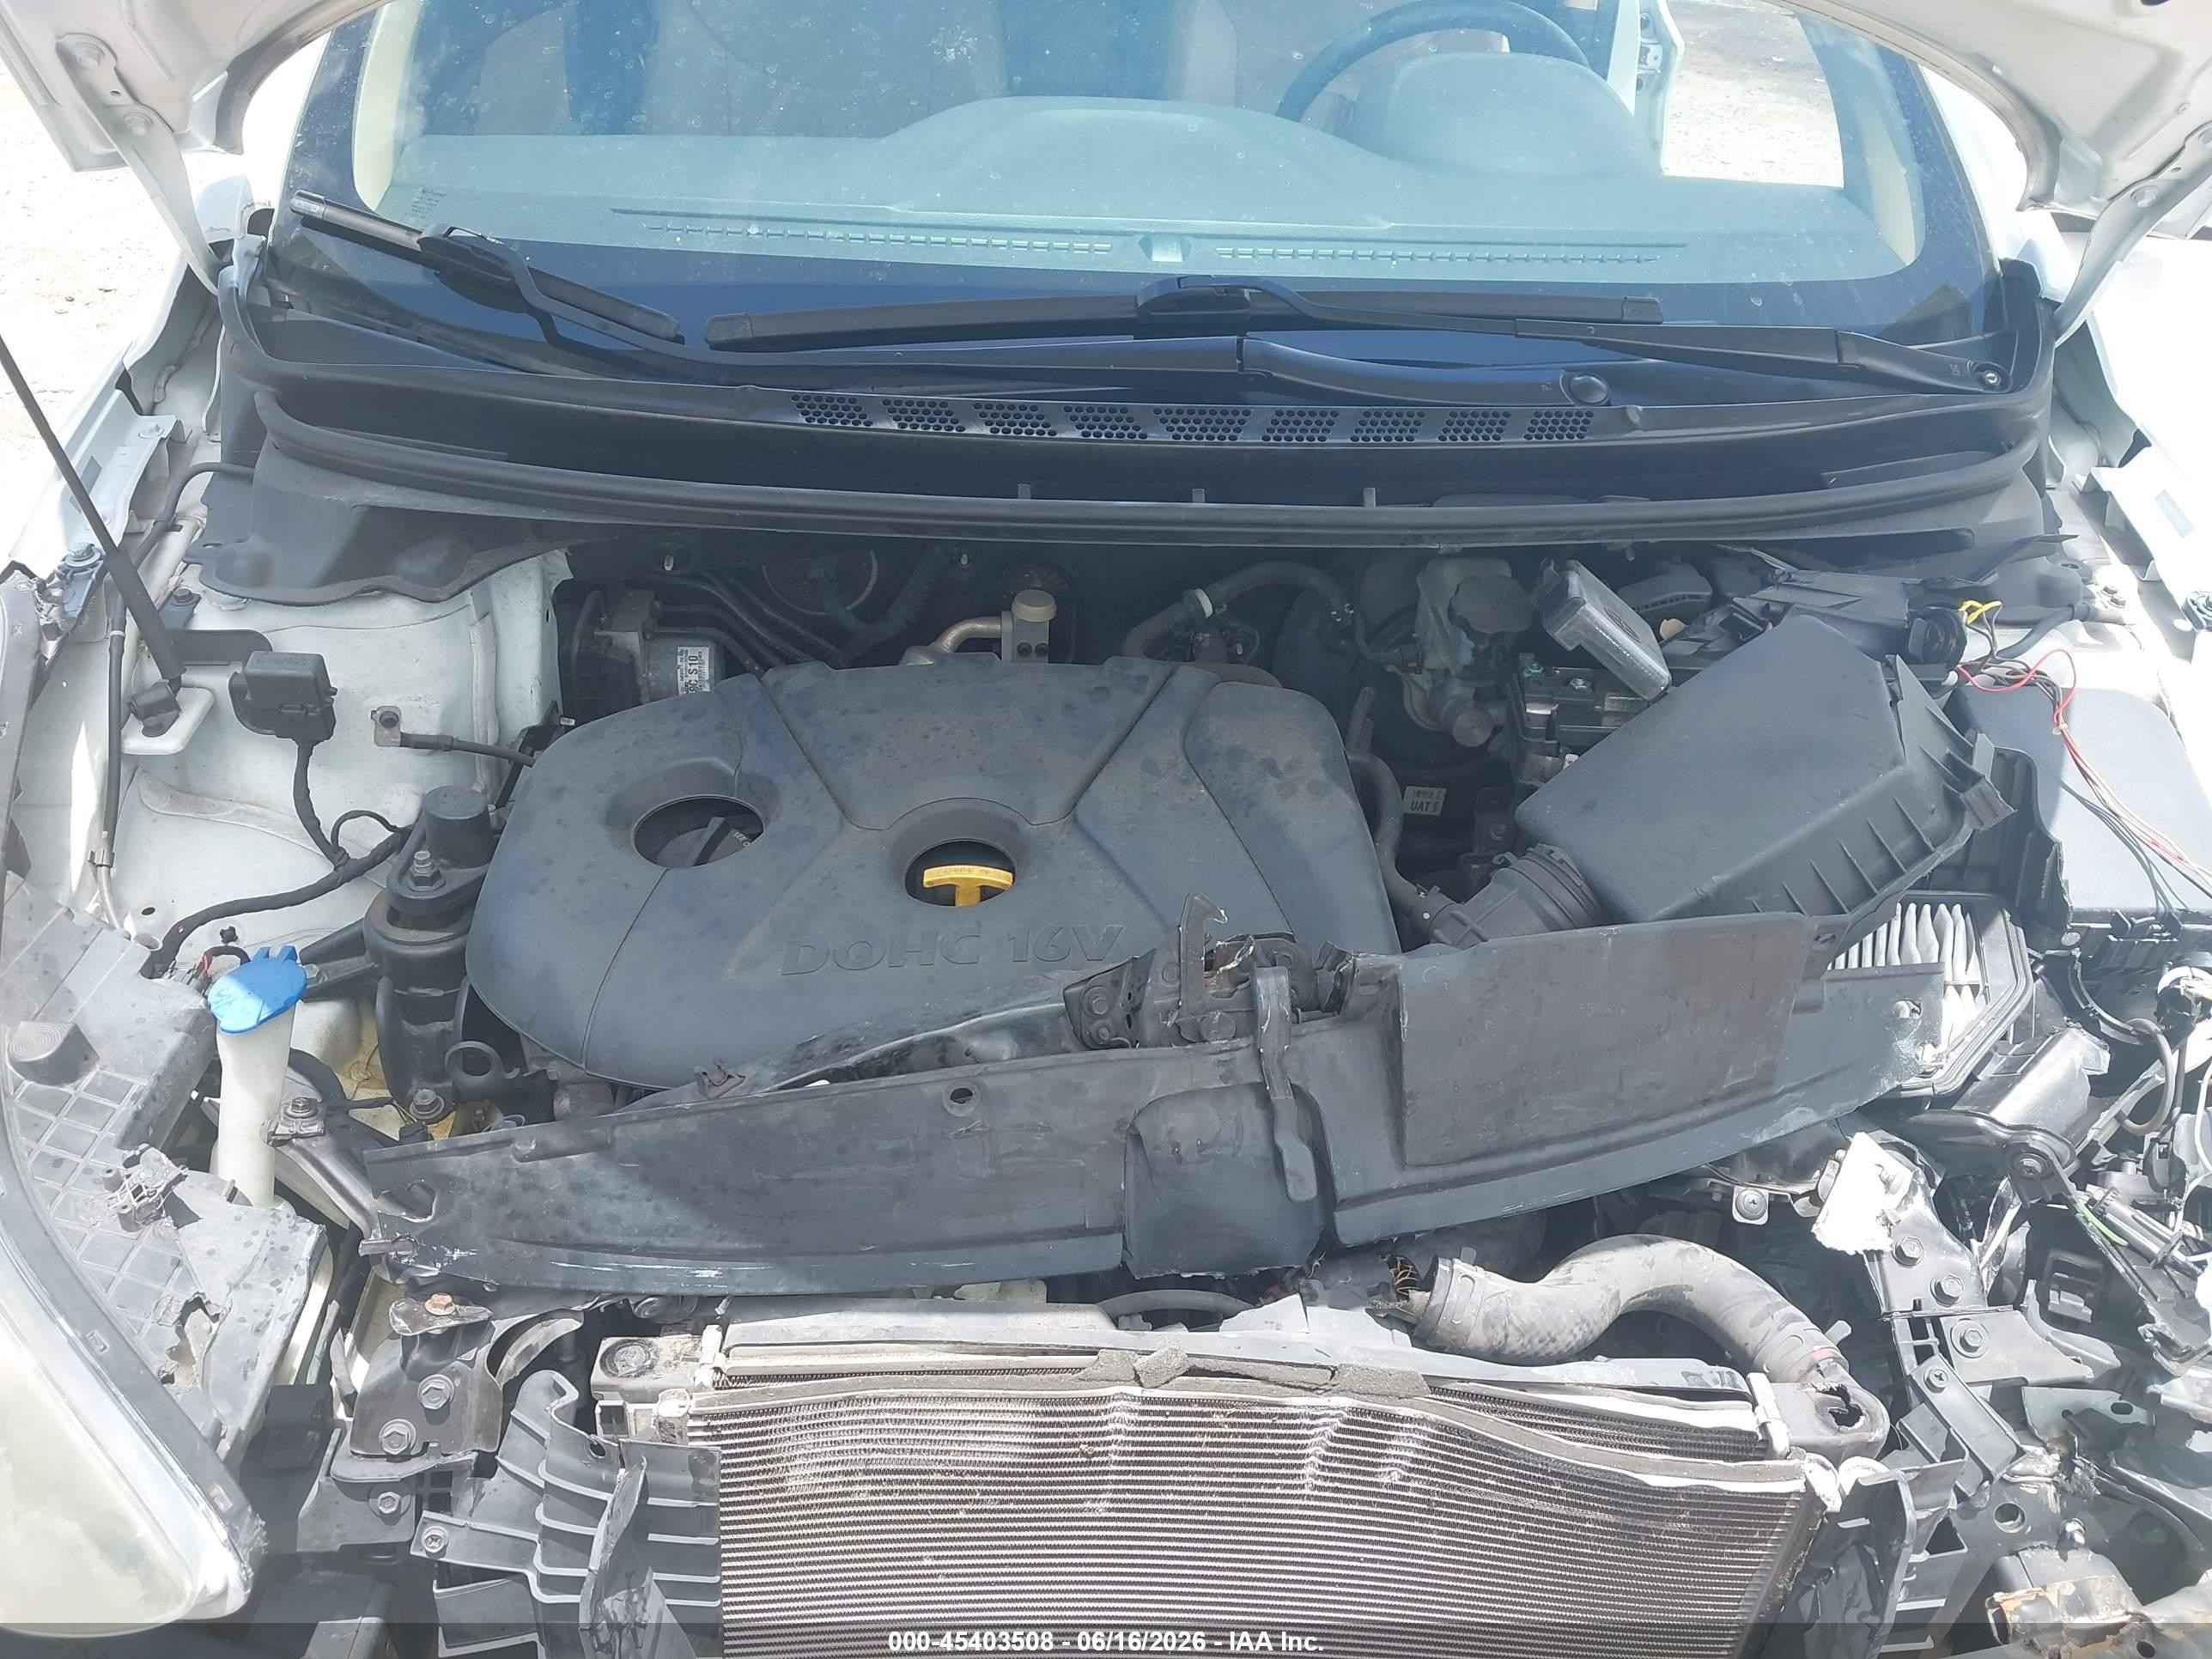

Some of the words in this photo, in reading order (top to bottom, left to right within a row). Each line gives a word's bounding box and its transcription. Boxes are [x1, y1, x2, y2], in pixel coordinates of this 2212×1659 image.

[688, 655, 698, 676] S10
[1410, 800, 1431, 811] UAT
[734, 831, 747, 842] SEE
[781, 930, 982, 975] DOHC
[1006, 924, 1125, 963] 16V
